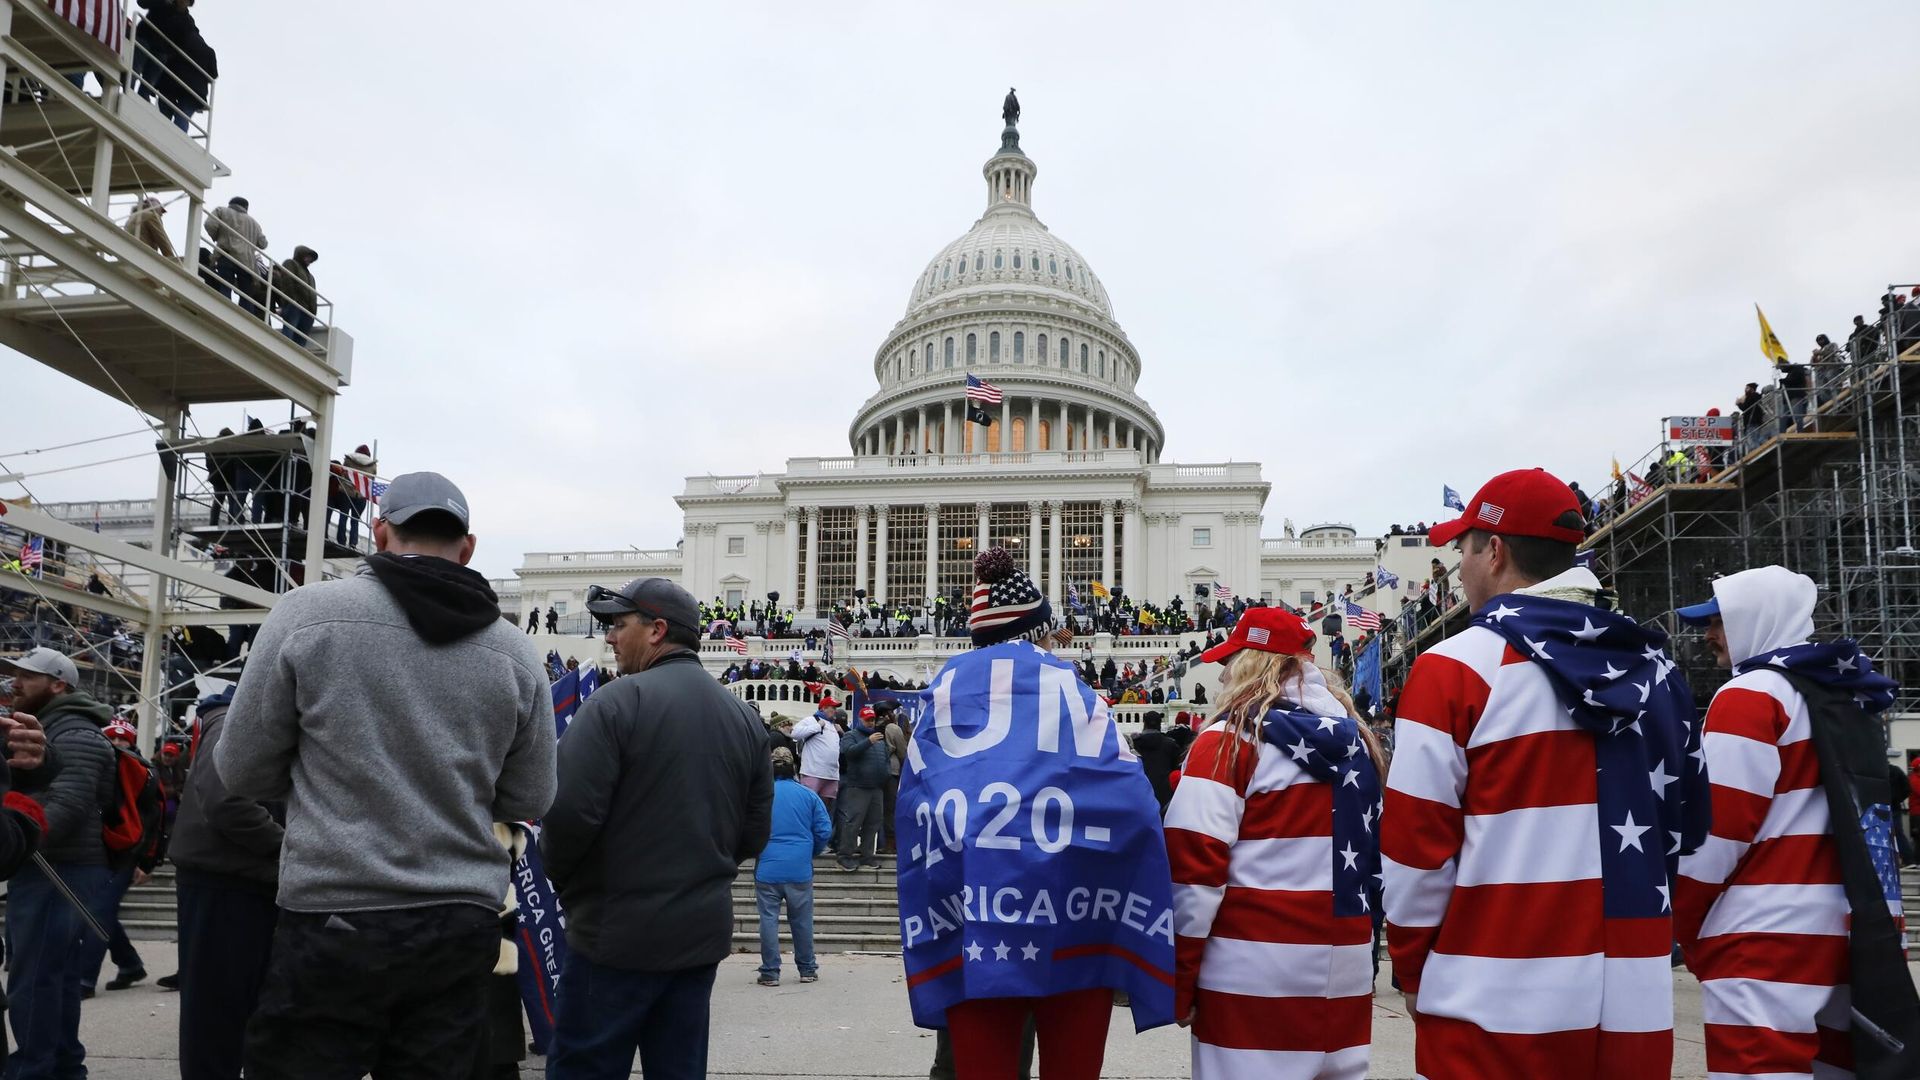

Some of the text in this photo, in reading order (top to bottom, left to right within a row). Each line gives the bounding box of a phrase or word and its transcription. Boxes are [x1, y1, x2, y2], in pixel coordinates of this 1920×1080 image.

[1681, 417, 1716, 427] STOP
[1680, 428, 1721, 439] STEAL
[539, 927, 562, 997] GREA
